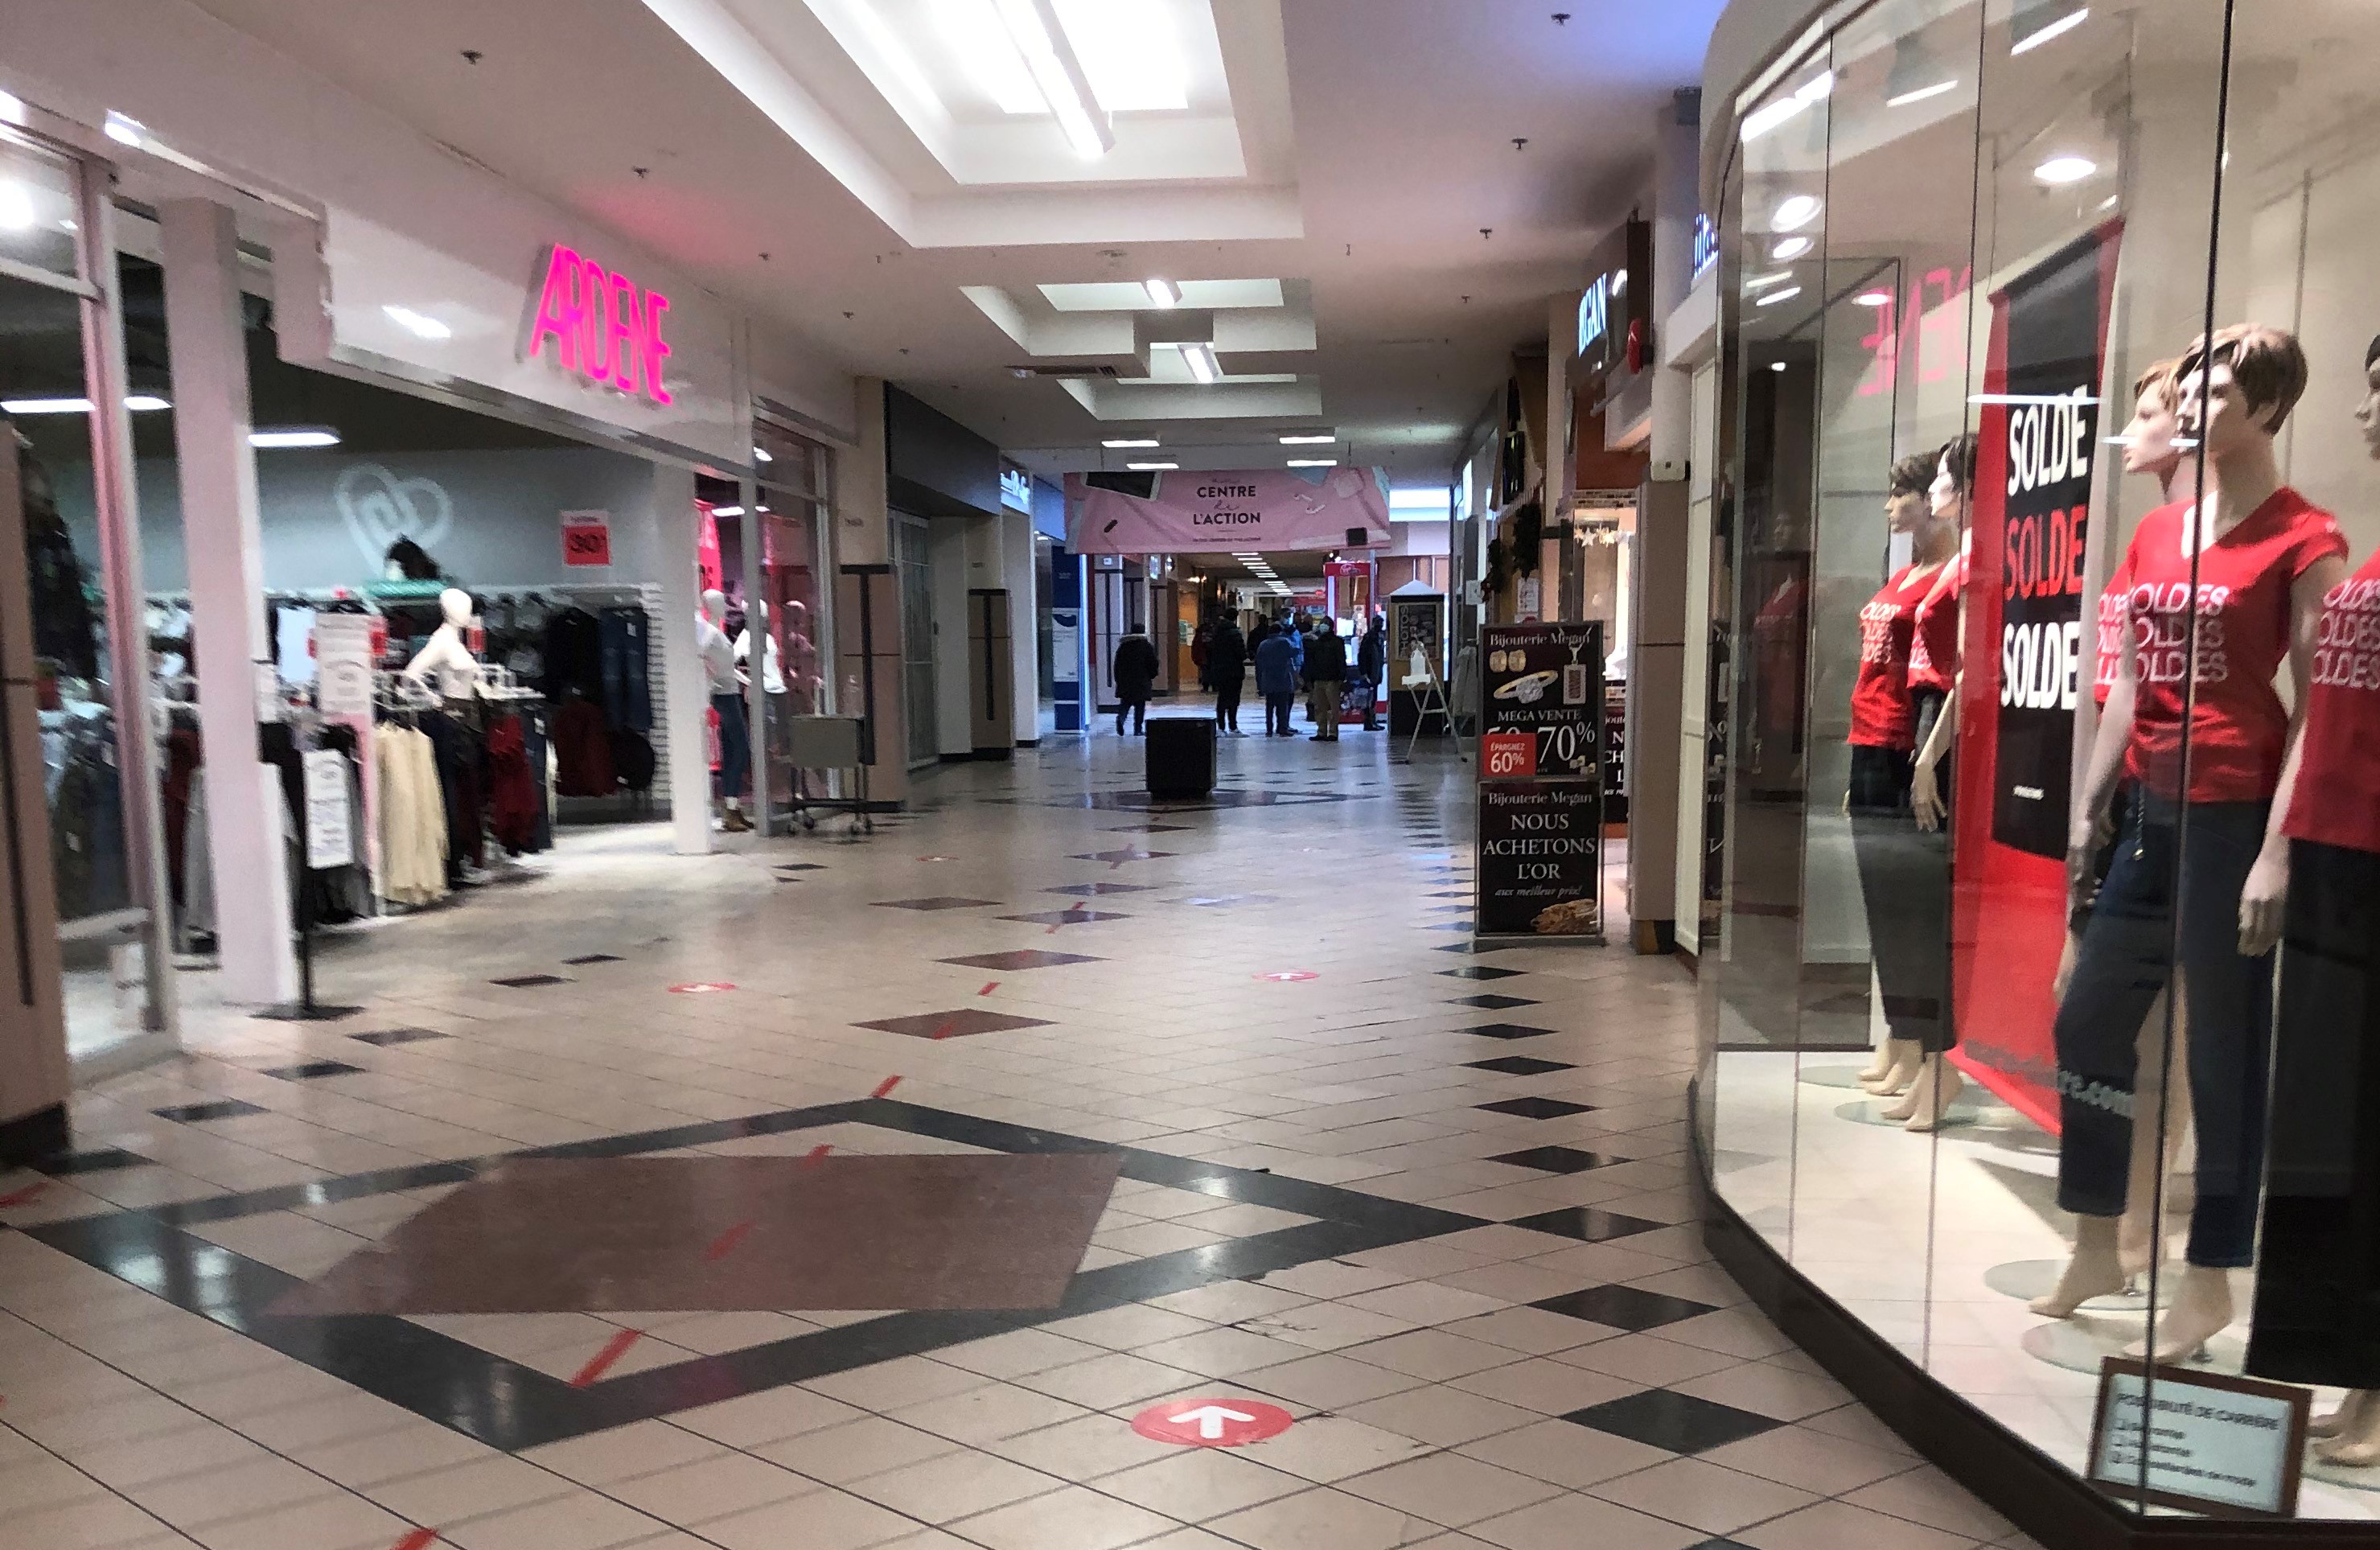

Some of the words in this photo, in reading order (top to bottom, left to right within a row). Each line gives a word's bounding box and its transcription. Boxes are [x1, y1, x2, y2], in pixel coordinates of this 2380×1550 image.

[529, 243, 672, 405] ARDENE
[2008, 384, 2088, 497] SOLDE
[1197, 486, 1256, 499] CENTRE
[1193, 512, 1261, 525] L'ACTION
[2004, 504, 2086, 601] SOLDE
[1490, 633, 1548, 648] Bijouterie
[2000, 622, 2080, 710] SOLDE
[1498, 710, 1535, 722] MEGA
[1538, 709, 1582, 721] VENTE
[1537, 721, 1596, 764] 70%
[1490, 752, 1525, 773] 60%
[1489, 792, 1548, 806] Bijouterie
[1551, 791, 1593, 806] Megan
[1511, 813, 1569, 831] NOUS
[1482, 837, 1596, 856] ACHETONS
[1517, 863, 1561, 880] L'OR
